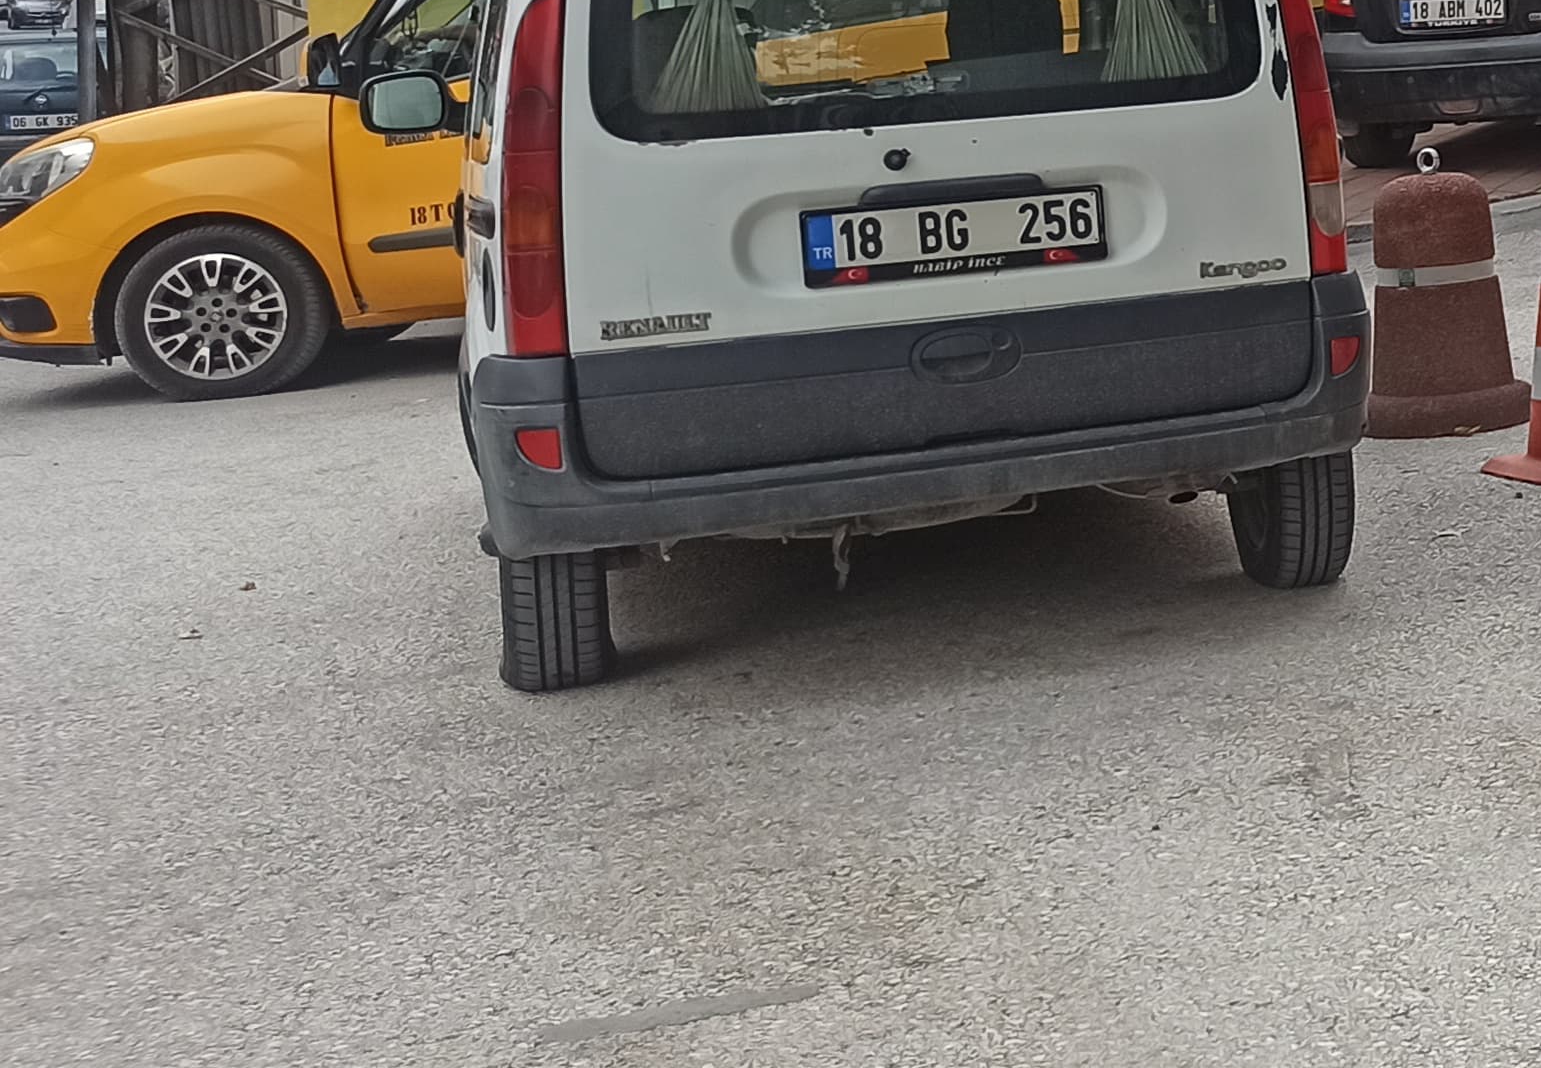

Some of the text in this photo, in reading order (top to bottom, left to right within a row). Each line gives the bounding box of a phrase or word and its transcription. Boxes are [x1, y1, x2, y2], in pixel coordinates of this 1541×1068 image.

[1412, 1, 1428, 20] 18
[1438, 0, 1466, 19] ABM
[12, 116, 27, 128] 06
[409, 206, 428, 226] 18
[430, 203, 444, 223] T
[812, 197, 1093, 262] TR 18 BG 256
[1199, 257, 1288, 279] Kangoo
[600, 311, 712, 341] RENAULT
